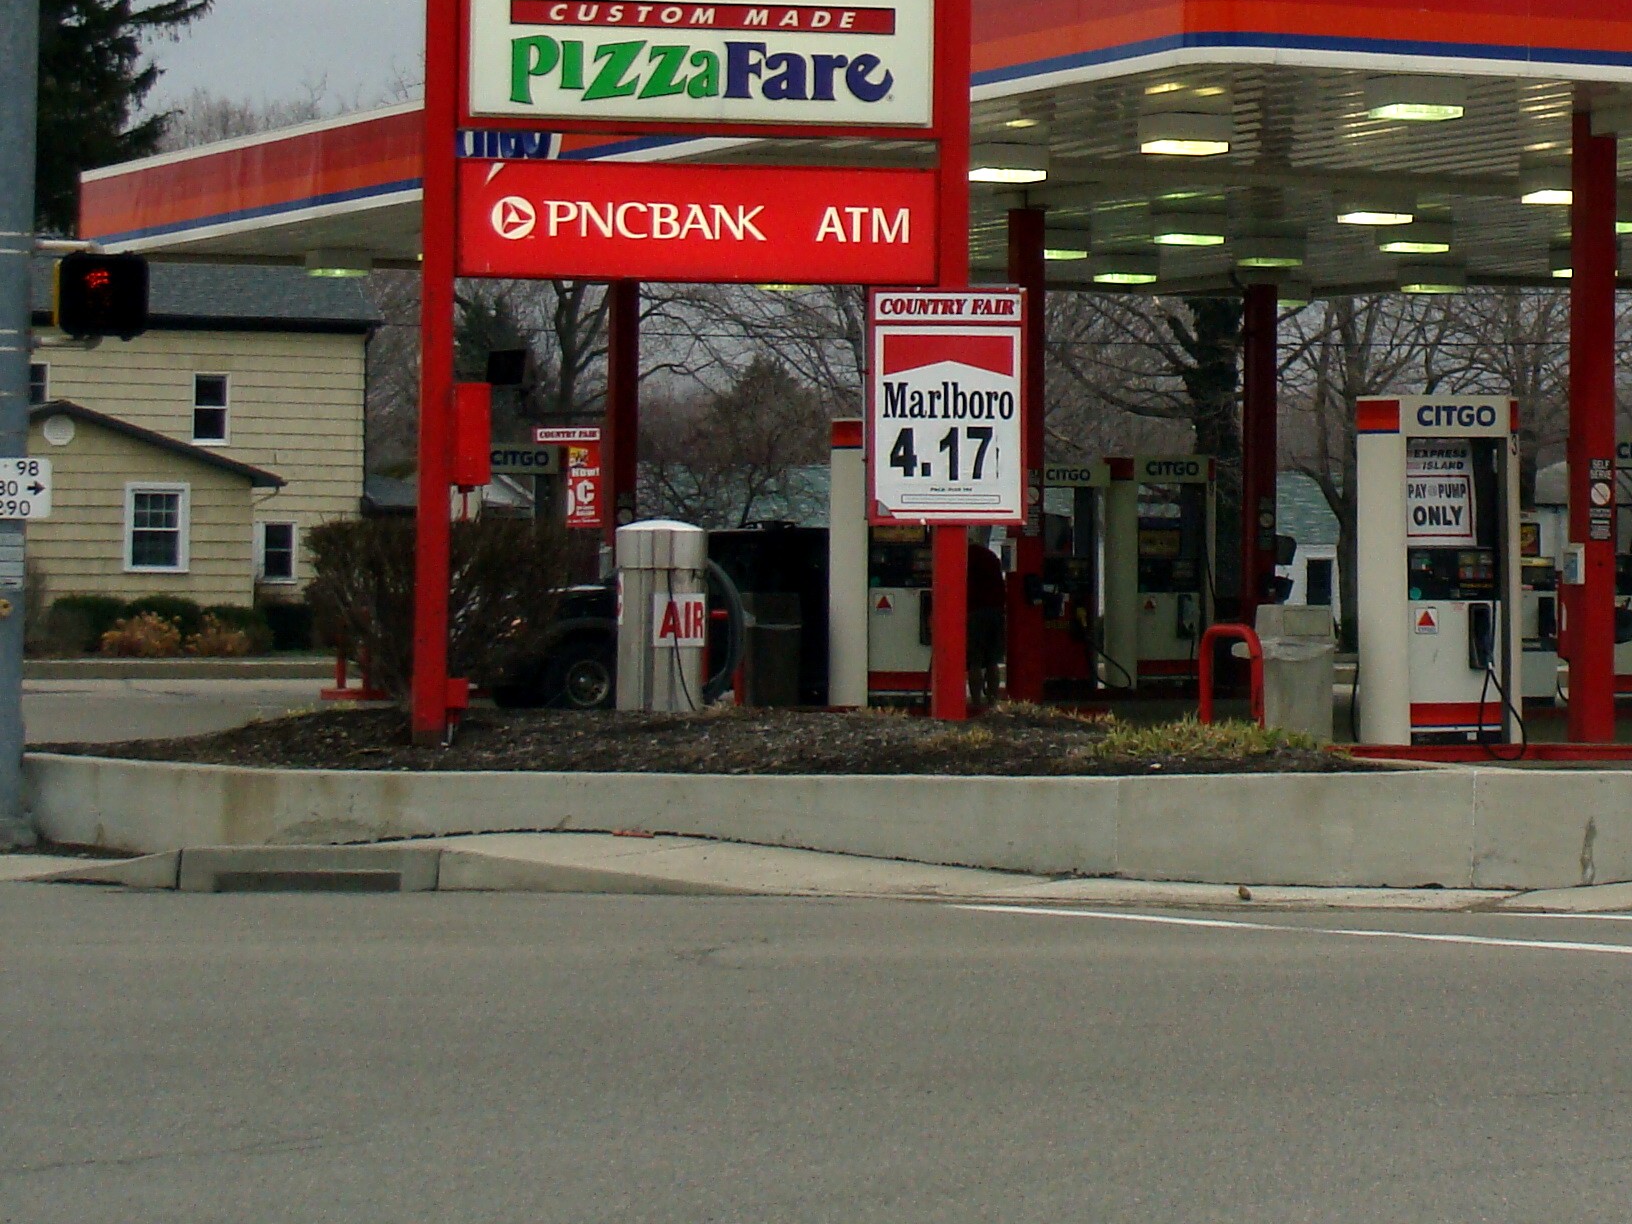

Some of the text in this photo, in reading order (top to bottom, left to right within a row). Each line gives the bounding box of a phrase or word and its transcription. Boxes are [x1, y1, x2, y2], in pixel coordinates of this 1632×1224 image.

[549, 3, 857, 29] CUSTOM MADE
[815, 207, 910, 243] ATM
[880, 298, 1015, 316] COUNTRY FAIR
[882, 381, 1015, 420] Marlboro
[1417, 405, 1496, 427] CITGO
[490, 450, 549, 466] CITGO
[890, 426, 994, 481] 4.17
[16, 460, 39, 476] 98
[1046, 468, 1091, 481] CITGO
[1146, 460, 1199, 476] CITGO
[1422, 461, 1464, 470] ISLAND
[1408, 483, 1427, 498] PAY
[1438, 483, 1467, 498] PUMP
[1413, 506, 1463, 526] ONLY
[659, 601, 704, 639] AIR
